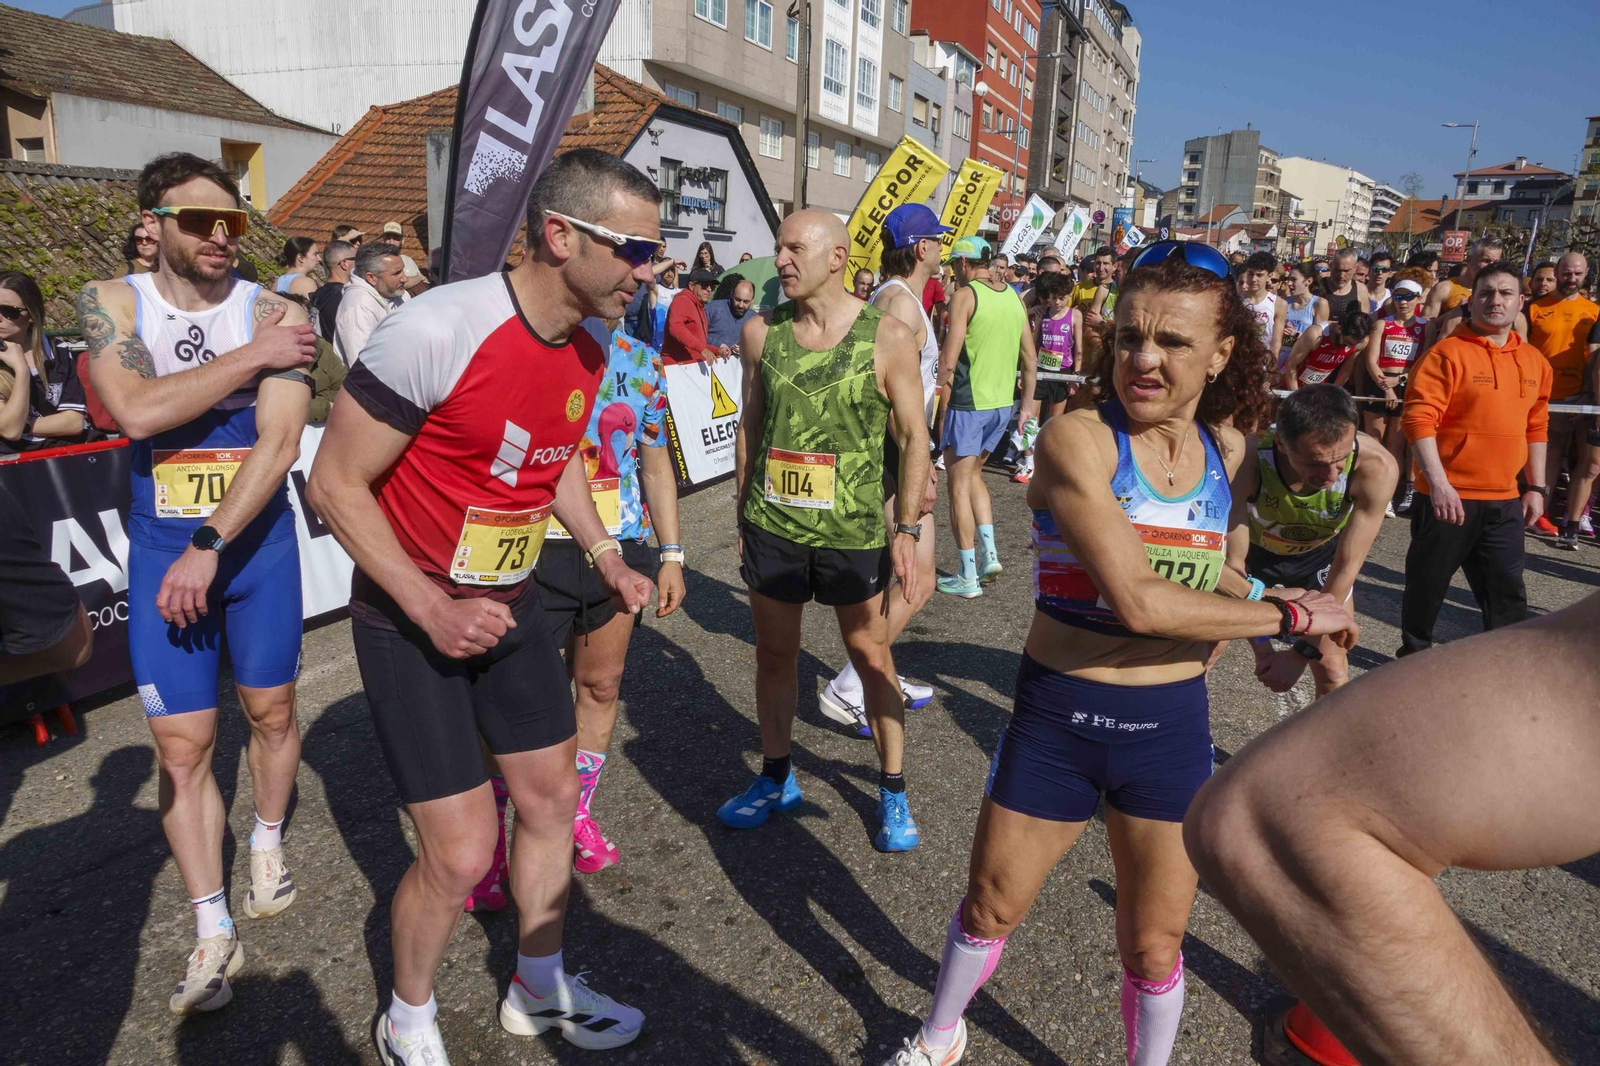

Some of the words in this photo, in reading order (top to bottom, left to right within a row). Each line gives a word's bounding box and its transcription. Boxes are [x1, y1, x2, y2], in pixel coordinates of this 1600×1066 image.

[484, 0, 574, 145] LAS
[679, 194, 719, 211] imprenta
[854, 153, 924, 248] ELECPOR
[901, 174, 926, 206] NTENIMIENTO
[943, 170, 983, 248] ELECPOR
[1009, 223, 1032, 255] urGas
[1060, 230, 1074, 257] urGas
[1040, 355, 1057, 367] 2198
[1391, 344, 1410, 355] 435
[665, 405, 687, 480] www.elecpo
[701, 420, 738, 447] ELECP
[188, 473, 225, 504] 70
[781, 470, 813, 497] 104
[501, 527, 533, 536] FODEOLAS
[1159, 531, 1191, 542] PORRIÑO
[495, 535, 530, 571] 73
[1146, 546, 1172, 557] JULIA
[1177, 550, 1210, 560] VAQUERO
[1117, 722, 1159, 732] seguros
